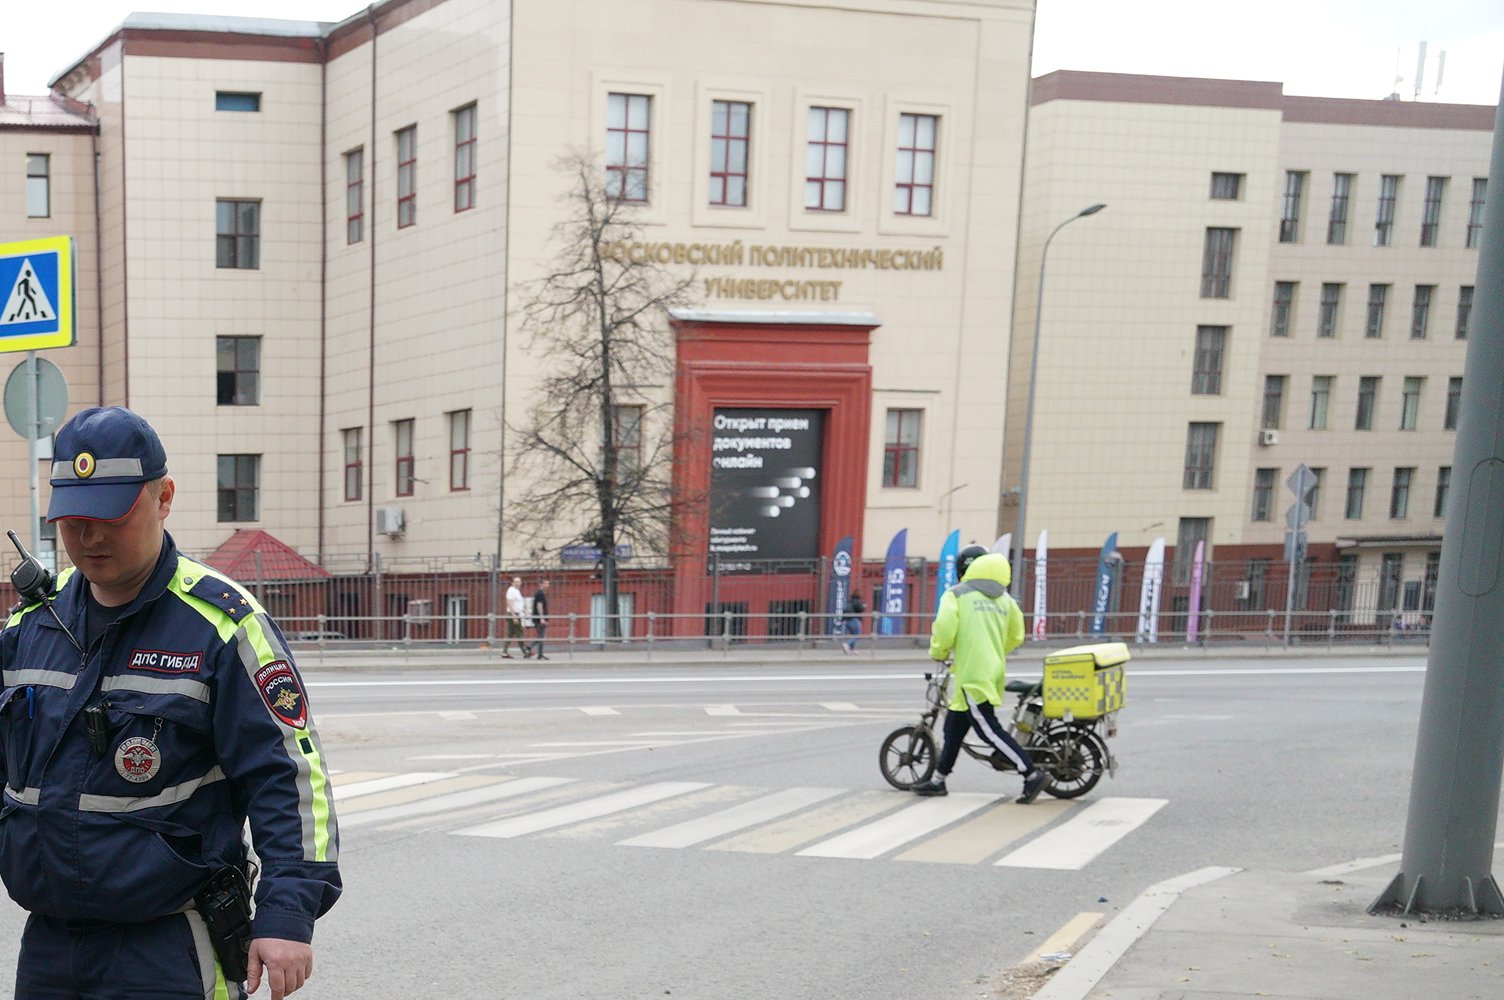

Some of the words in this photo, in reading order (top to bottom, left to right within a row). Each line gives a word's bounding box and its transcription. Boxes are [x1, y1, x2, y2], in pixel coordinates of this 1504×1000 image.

[749, 244, 944, 270] ПОЛИТЕХНИЧЕСКИЙ
[704, 278, 843, 301] УНИВЕРСИТЕТ
[714, 414, 766, 433] Открыт
[767, 417, 809, 433] прием
[712, 437, 792, 452] документов
[131, 653, 158, 667] ДПС
[160, 654, 199, 670] ГИБДД
[258, 663, 287, 682] ПОЛИЦИЯ
[265, 676, 293, 694] РОССИЯ
